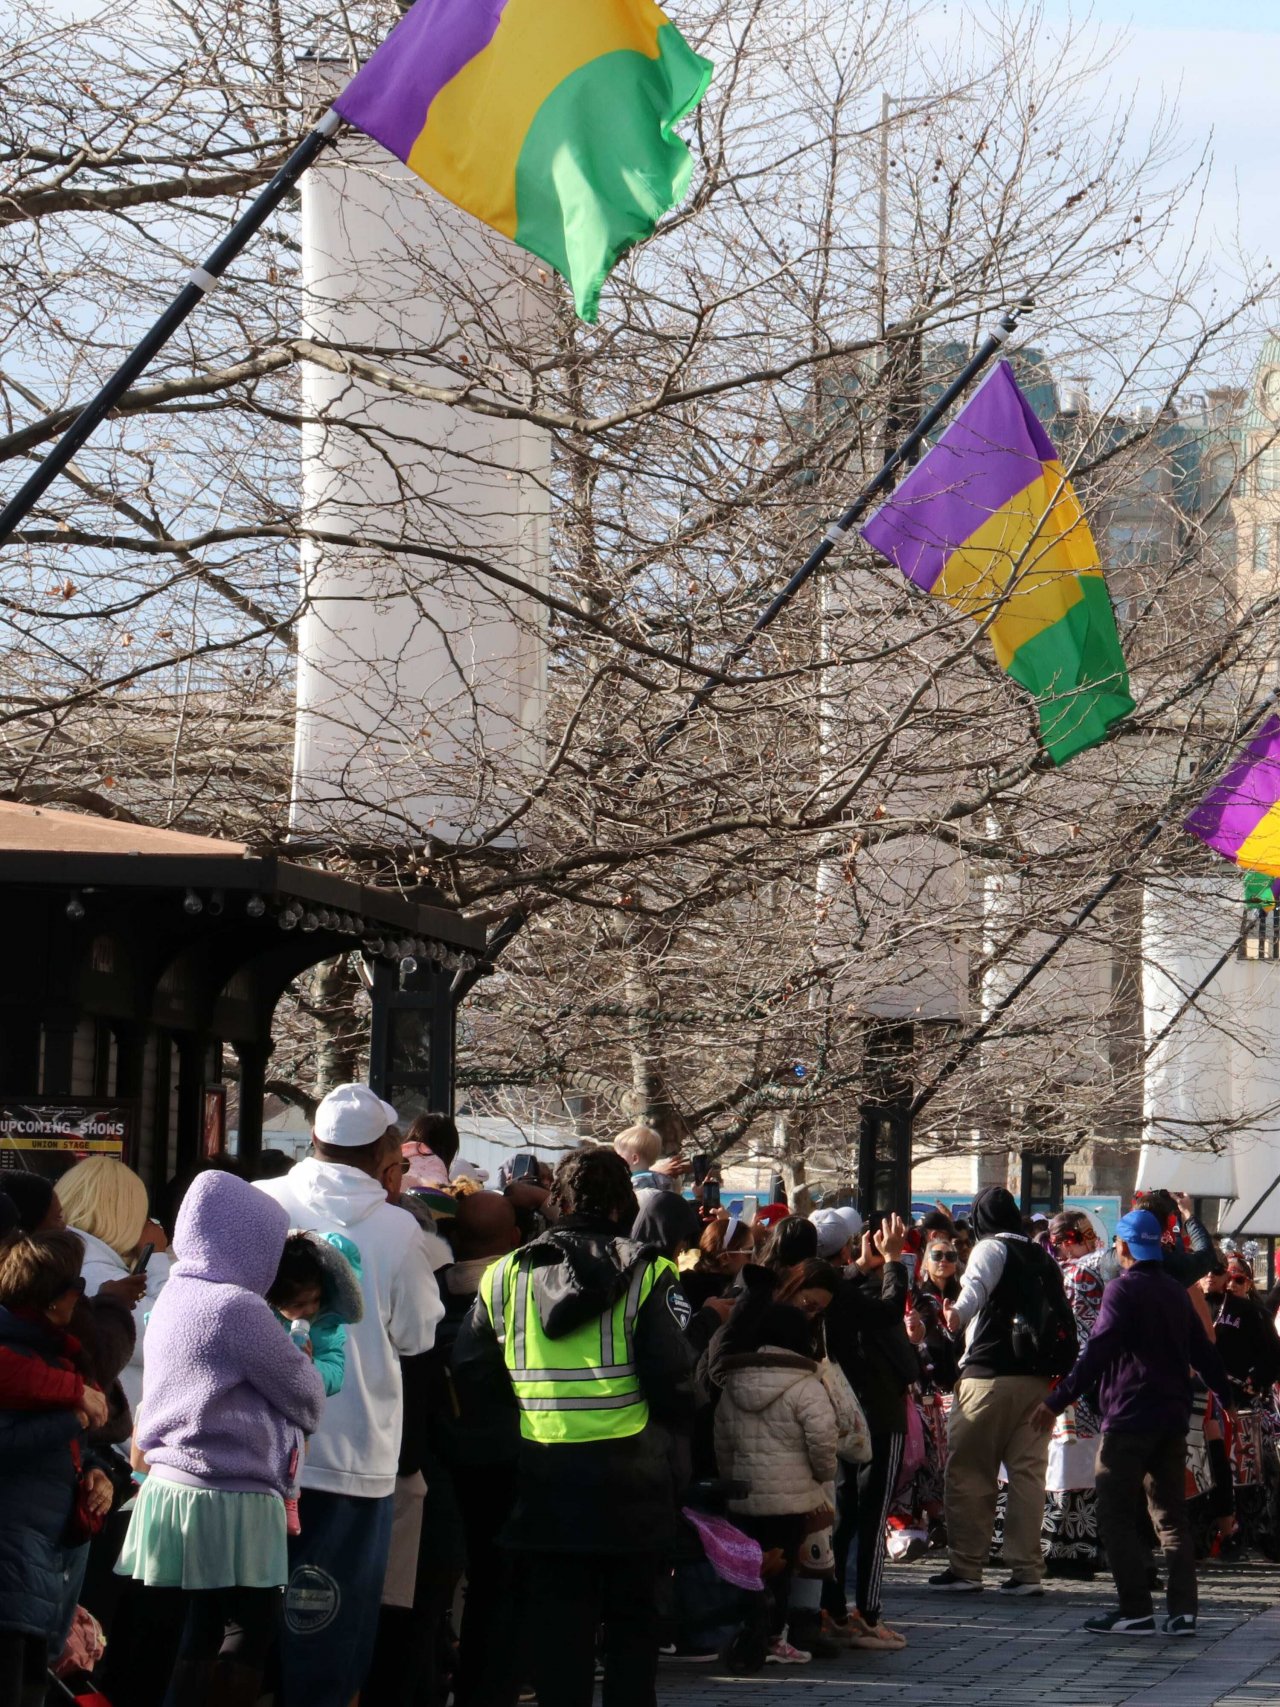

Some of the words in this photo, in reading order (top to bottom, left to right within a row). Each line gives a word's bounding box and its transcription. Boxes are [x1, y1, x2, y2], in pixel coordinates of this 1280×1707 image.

[0, 1120, 71, 1134] UPCOMING
[79, 1122, 124, 1136] SHOWS
[32, 1140, 58, 1149] UNION
[63, 1141, 90, 1150] STAGE
